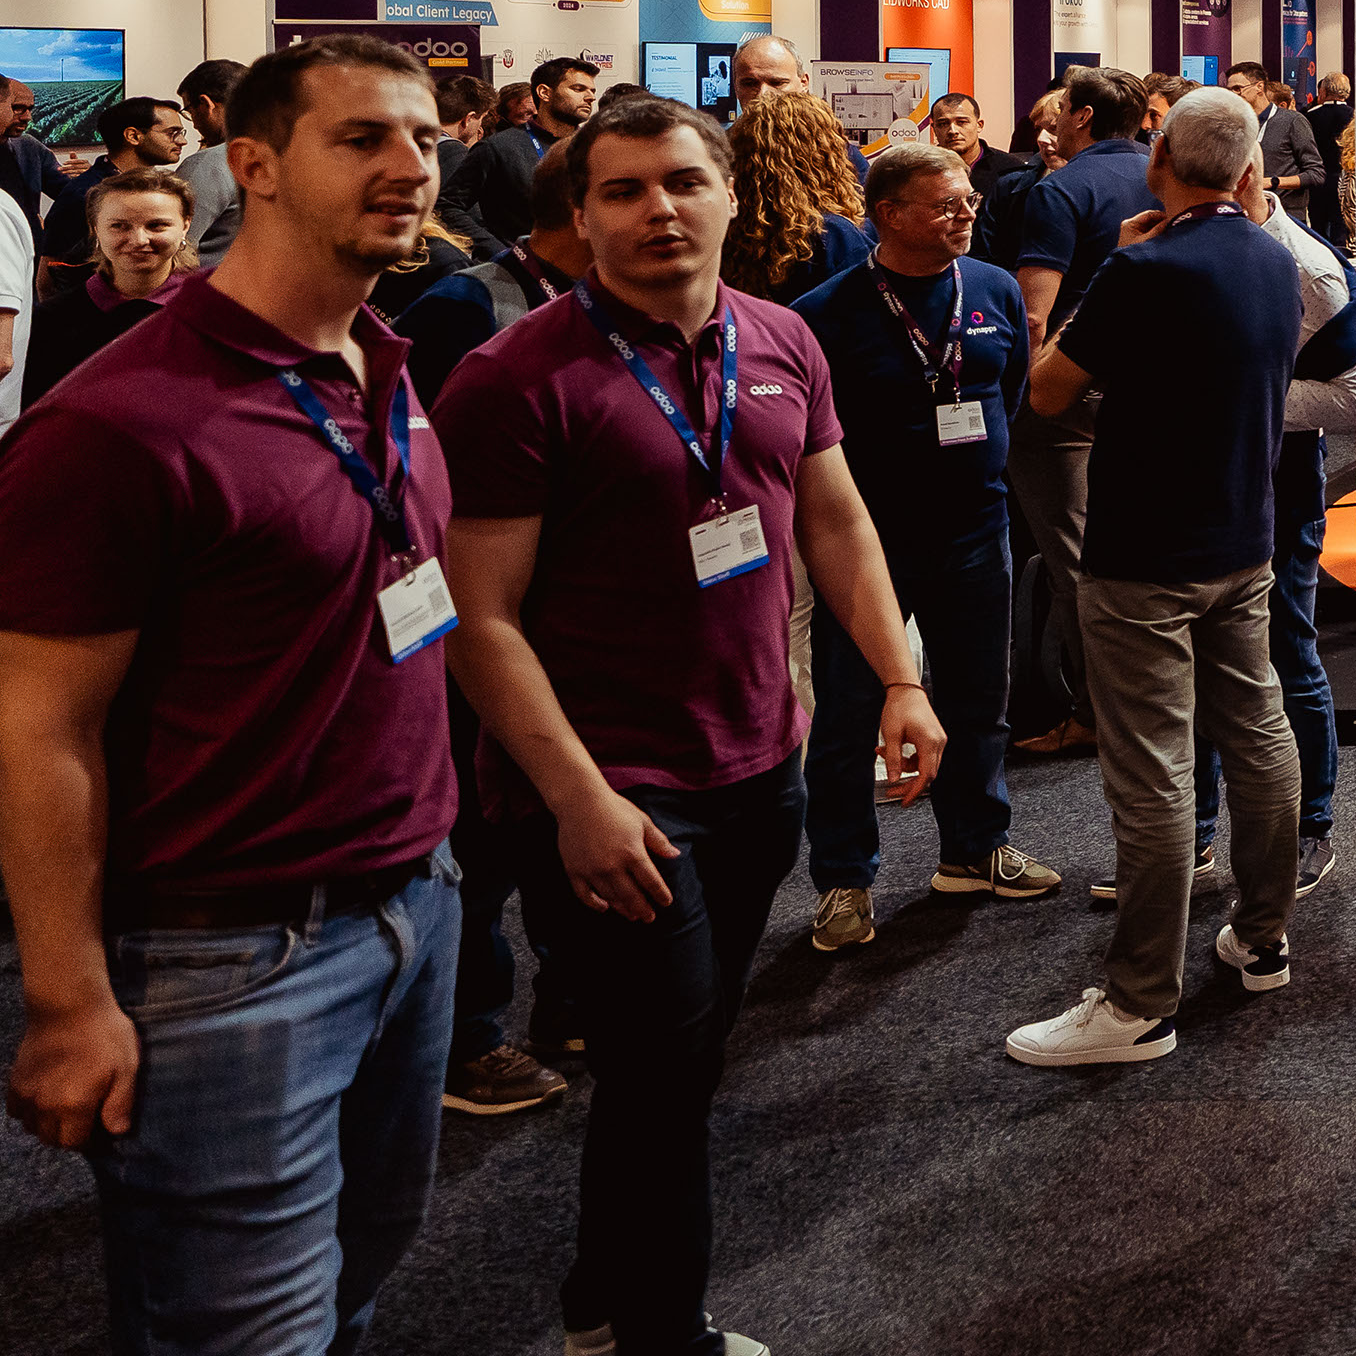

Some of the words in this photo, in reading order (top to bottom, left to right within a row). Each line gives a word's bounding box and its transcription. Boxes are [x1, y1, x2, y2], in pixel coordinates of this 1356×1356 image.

[416, 4, 450, 18] Client
[452, 6, 492, 23] Legacy
[820, 68, 874, 76] BROWSEINFO
[891, 127, 917, 137] odoo
[540, 278, 557, 299] odoo
[726, 324, 737, 352] odoo
[913, 328, 929, 346] odoo
[967, 325, 997, 335] dynapps
[608, 332, 635, 360] odoo
[726, 379, 737, 409] odoo
[750, 383, 783, 395] odoo
[650, 386, 675, 415] odoo
[324, 418, 354, 454] odoo
